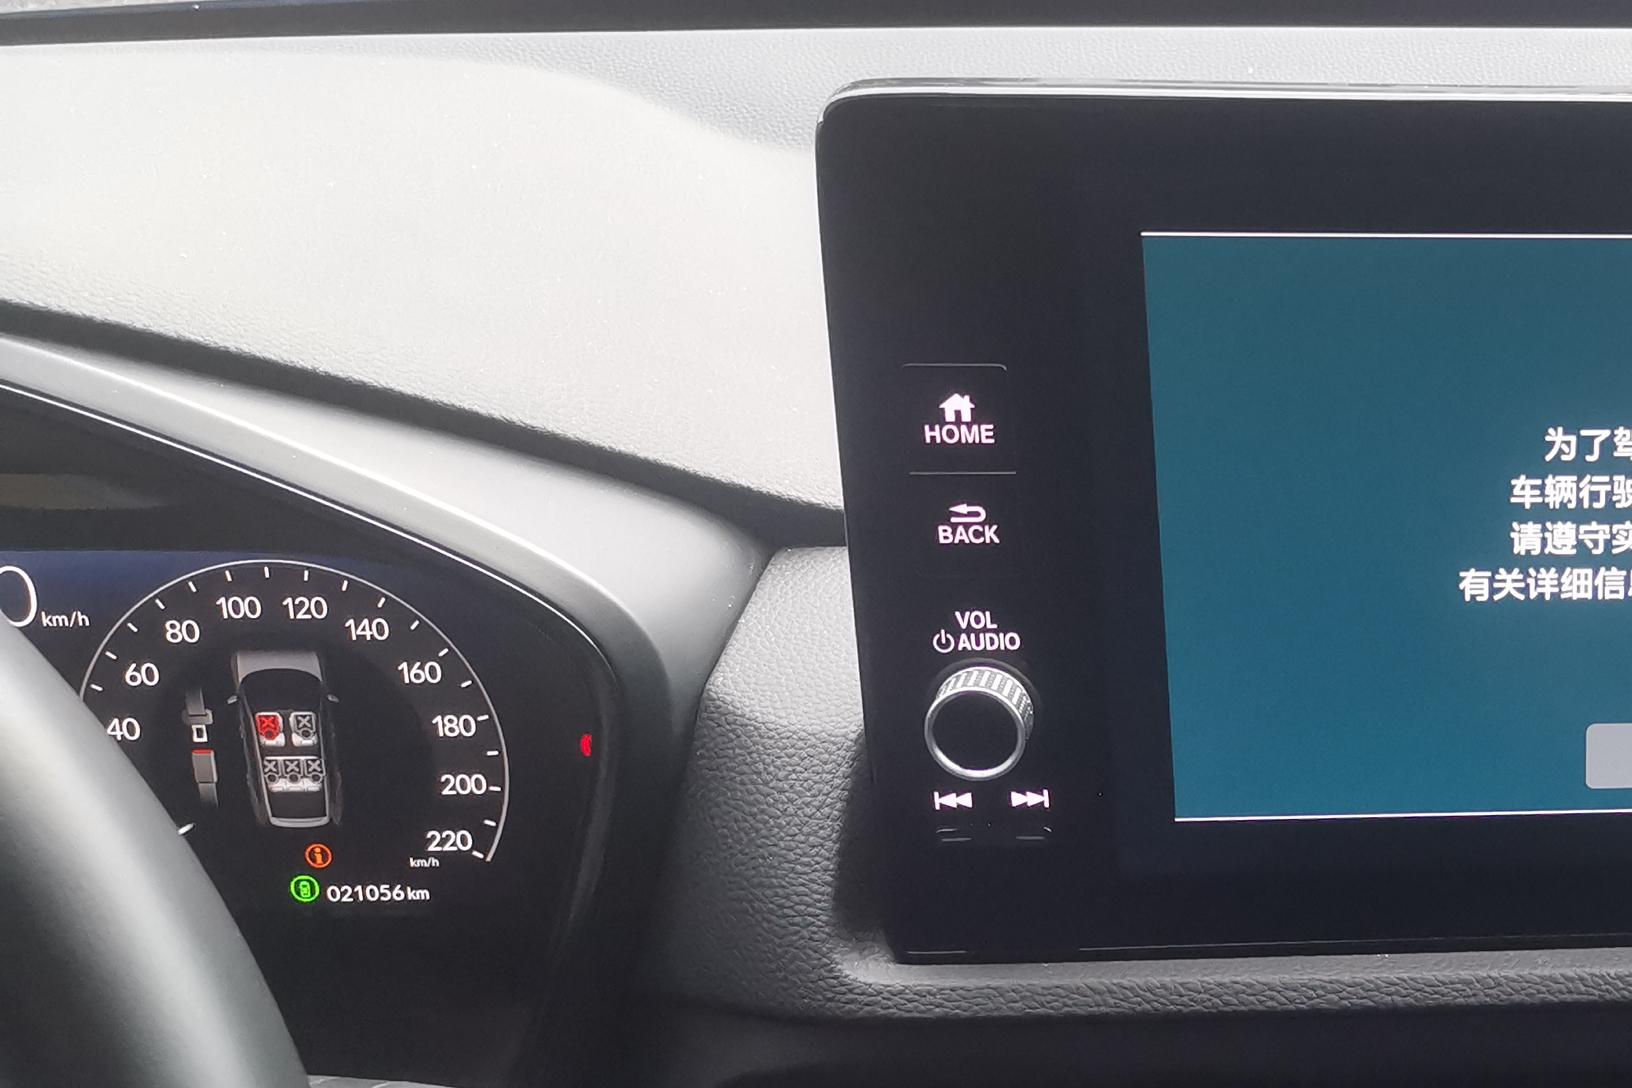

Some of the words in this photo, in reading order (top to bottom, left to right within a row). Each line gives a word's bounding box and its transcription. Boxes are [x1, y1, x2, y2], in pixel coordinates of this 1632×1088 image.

[924, 424, 995, 444] HOME
[937, 524, 1000, 544] BACK
[41, 608, 90, 628] km/h
[215, 596, 262, 619] 100
[282, 596, 328, 620] 120
[164, 619, 200, 644] 80
[344, 617, 390, 641] 140
[954, 610, 998, 630] VOL
[957, 631, 1021, 651] AUDIO
[124, 662, 160, 687] 60
[397, 661, 442, 684] 160
[106, 714, 142, 743] 40
[431, 714, 477, 738] 180
[440, 773, 487, 796] 200
[426, 829, 473, 852] 220
[409, 855, 440, 868] km/h
[326, 884, 404, 903] 021056
[406, 886, 430, 901] km
